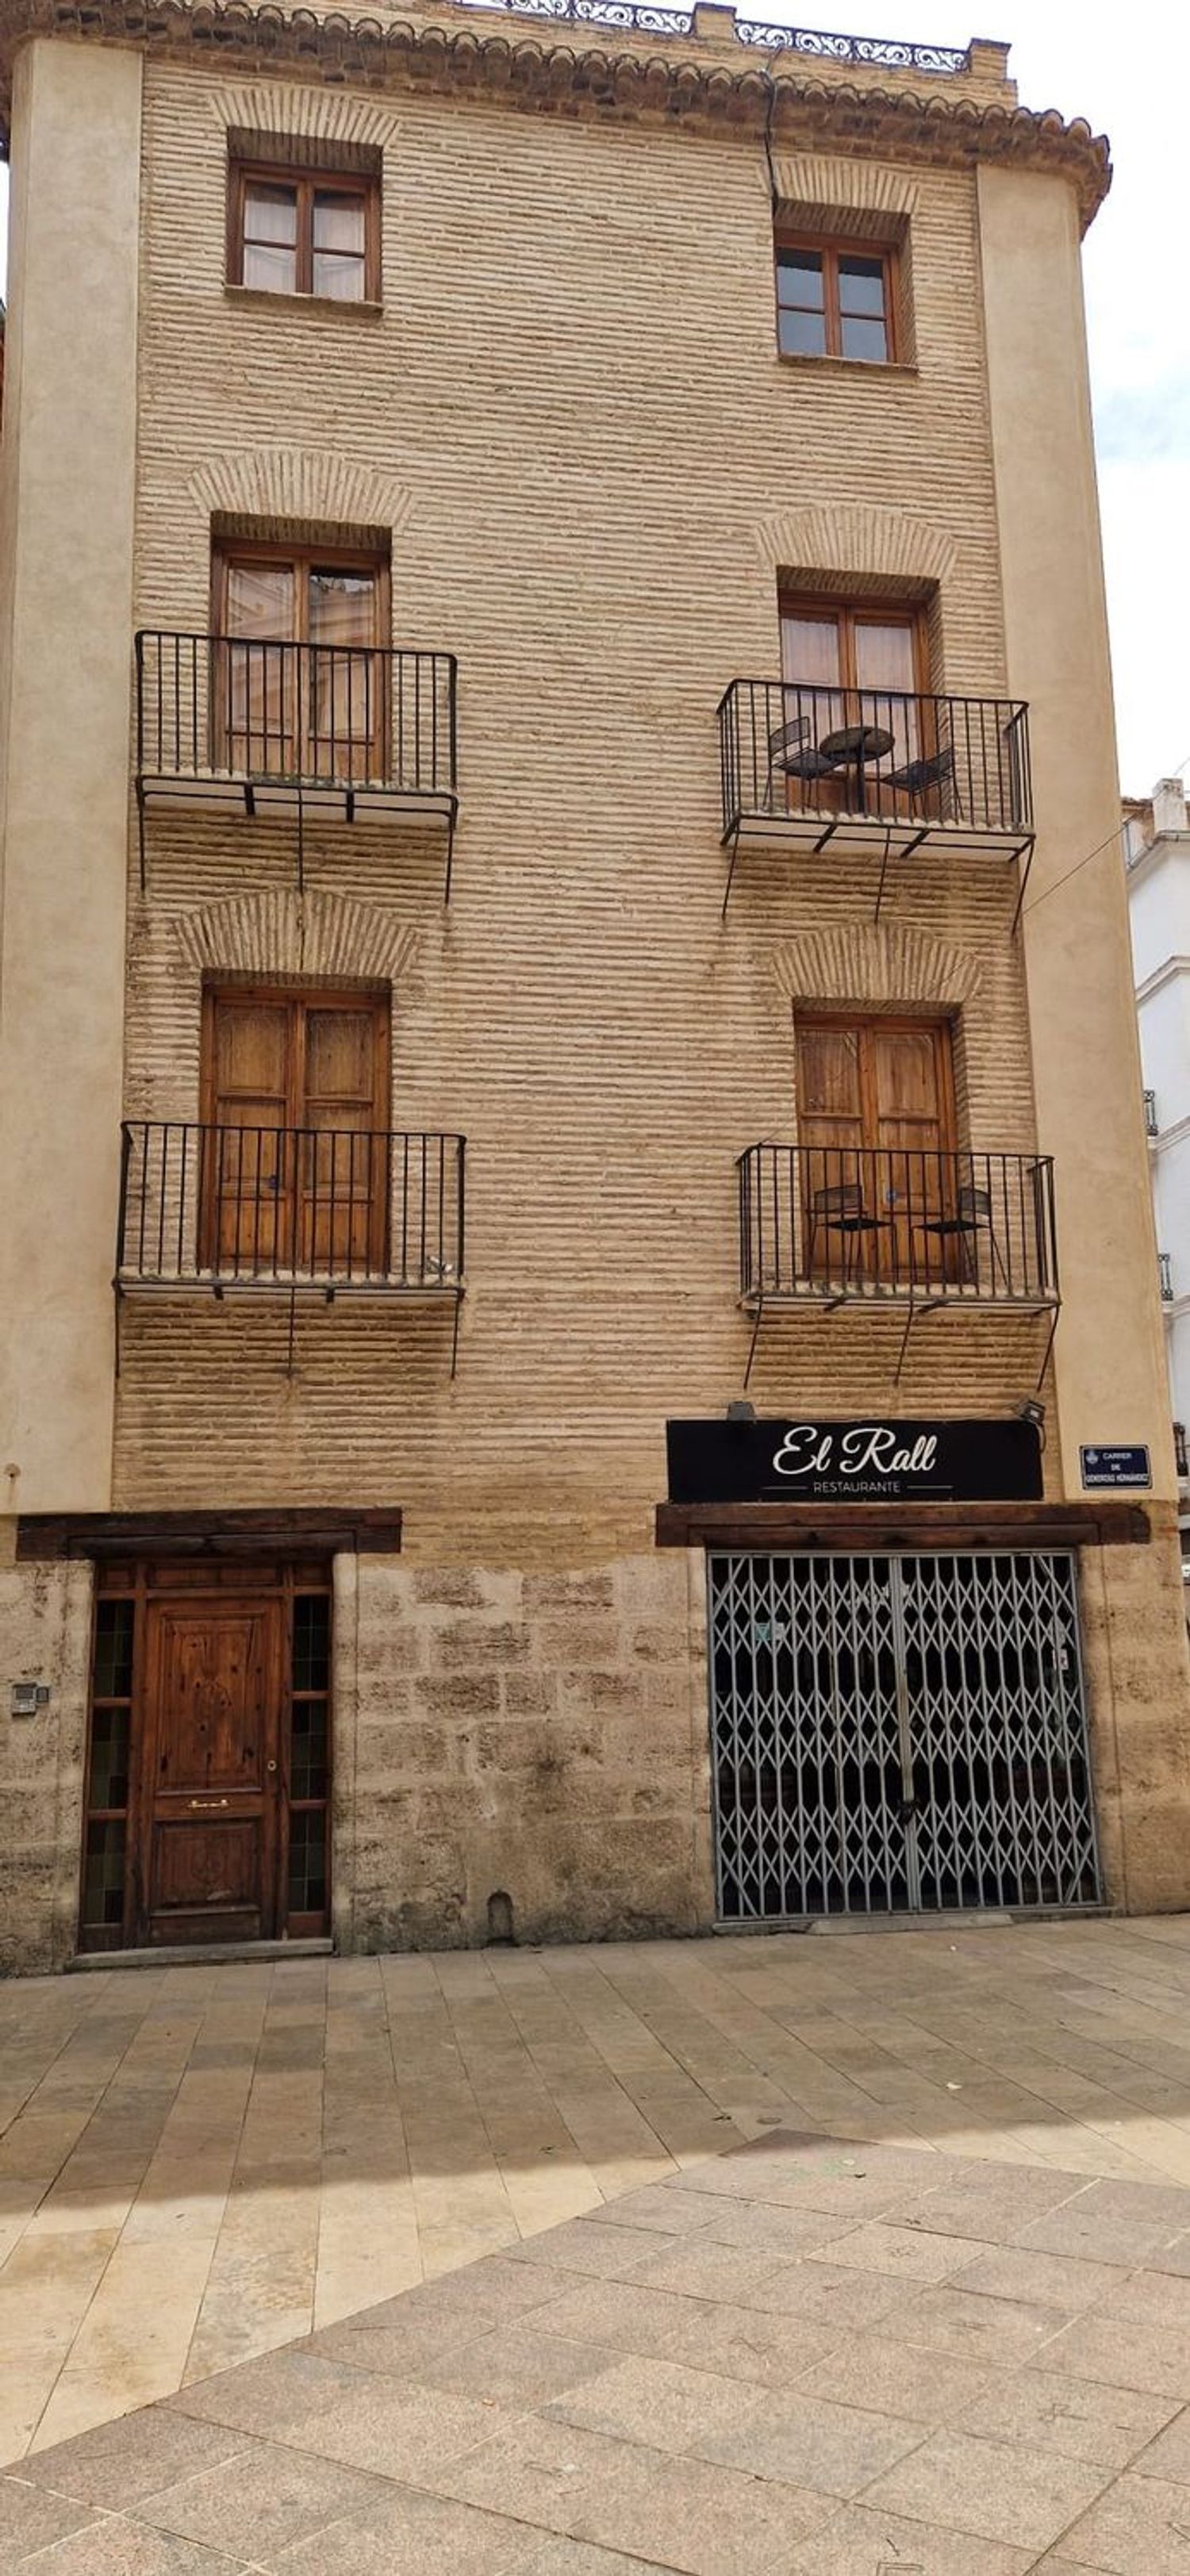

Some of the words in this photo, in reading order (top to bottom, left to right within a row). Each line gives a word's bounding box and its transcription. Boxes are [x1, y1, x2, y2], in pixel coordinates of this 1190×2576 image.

[773, 1426, 832, 1475] El
[839, 1427, 938, 1474] Rall
[814, 1481, 900, 1493] RESTAURANTE
